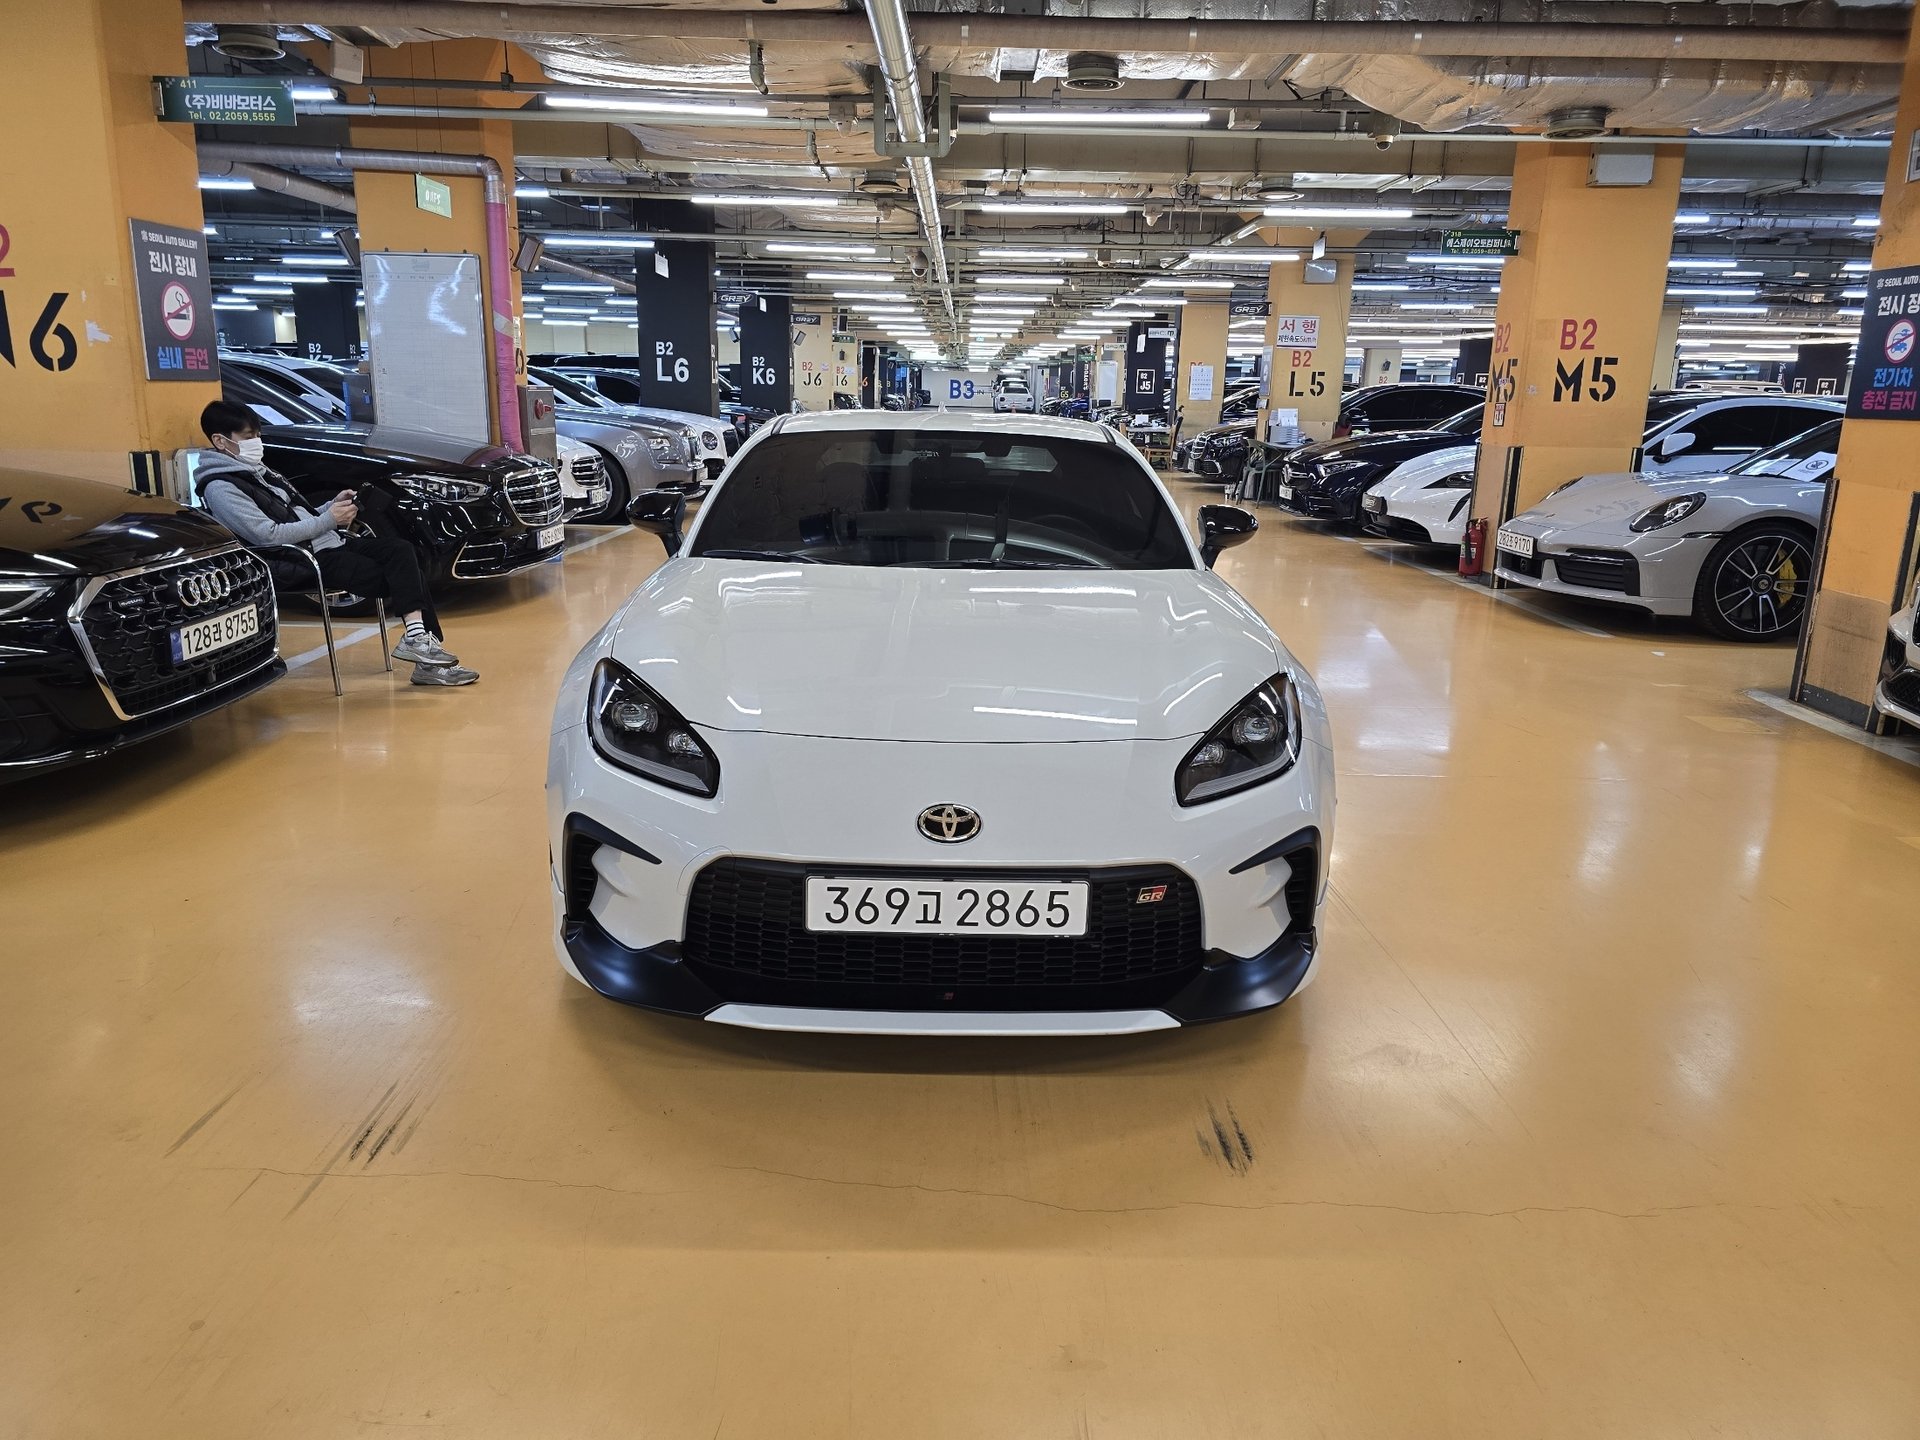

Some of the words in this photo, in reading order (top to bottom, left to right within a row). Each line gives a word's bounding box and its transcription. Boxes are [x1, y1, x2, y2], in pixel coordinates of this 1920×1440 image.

[180, 80, 197, 89] 411
[184, 94, 277, 111] (주)비바모터스
[209, 111, 276, 121] 02.2059.5555
[148, 232, 165, 245] SEOUL
[165, 235, 178, 247] AUTO
[178, 237, 198, 250] GALLERY
[148, 250, 173, 275] 전시
[174, 254, 198, 278] 장내
[1884, 278, 1902, 288] SEOUL
[1903, 276, 1919, 286] AUTO
[720, 294, 752, 303] GREY
[1877, 296, 1905, 317] 전시
[1234, 304, 1263, 313] GREY
[1494, 322, 1512, 354] B2
[1559, 318, 1598, 351] B2
[308, 342, 322, 354] B2
[655, 341, 674, 355] B2
[157, 346, 183, 370] 실내
[185, 348, 210, 370] 금연
[752, 356, 765, 367] B2
[802, 361, 813, 371] B2
[1291, 350, 1312, 368] B2
[656, 357, 690, 383] L6
[752, 367, 776, 385] K6
[836, 366, 845, 374] B2
[1552, 356, 1619, 402] M5
[1873, 367, 1914, 388] 전기차
[803, 373, 822, 387] J6
[1140, 381, 1151, 390] J5
[1288, 371, 1325, 397] L5
[1378, 376, 1389, 384] B2
[1488, 358, 1518, 403] M5
[949, 379, 975, 400] B3
[1861, 391, 1888, 411] 충전
[1889, 390, 1917, 411] 금지
